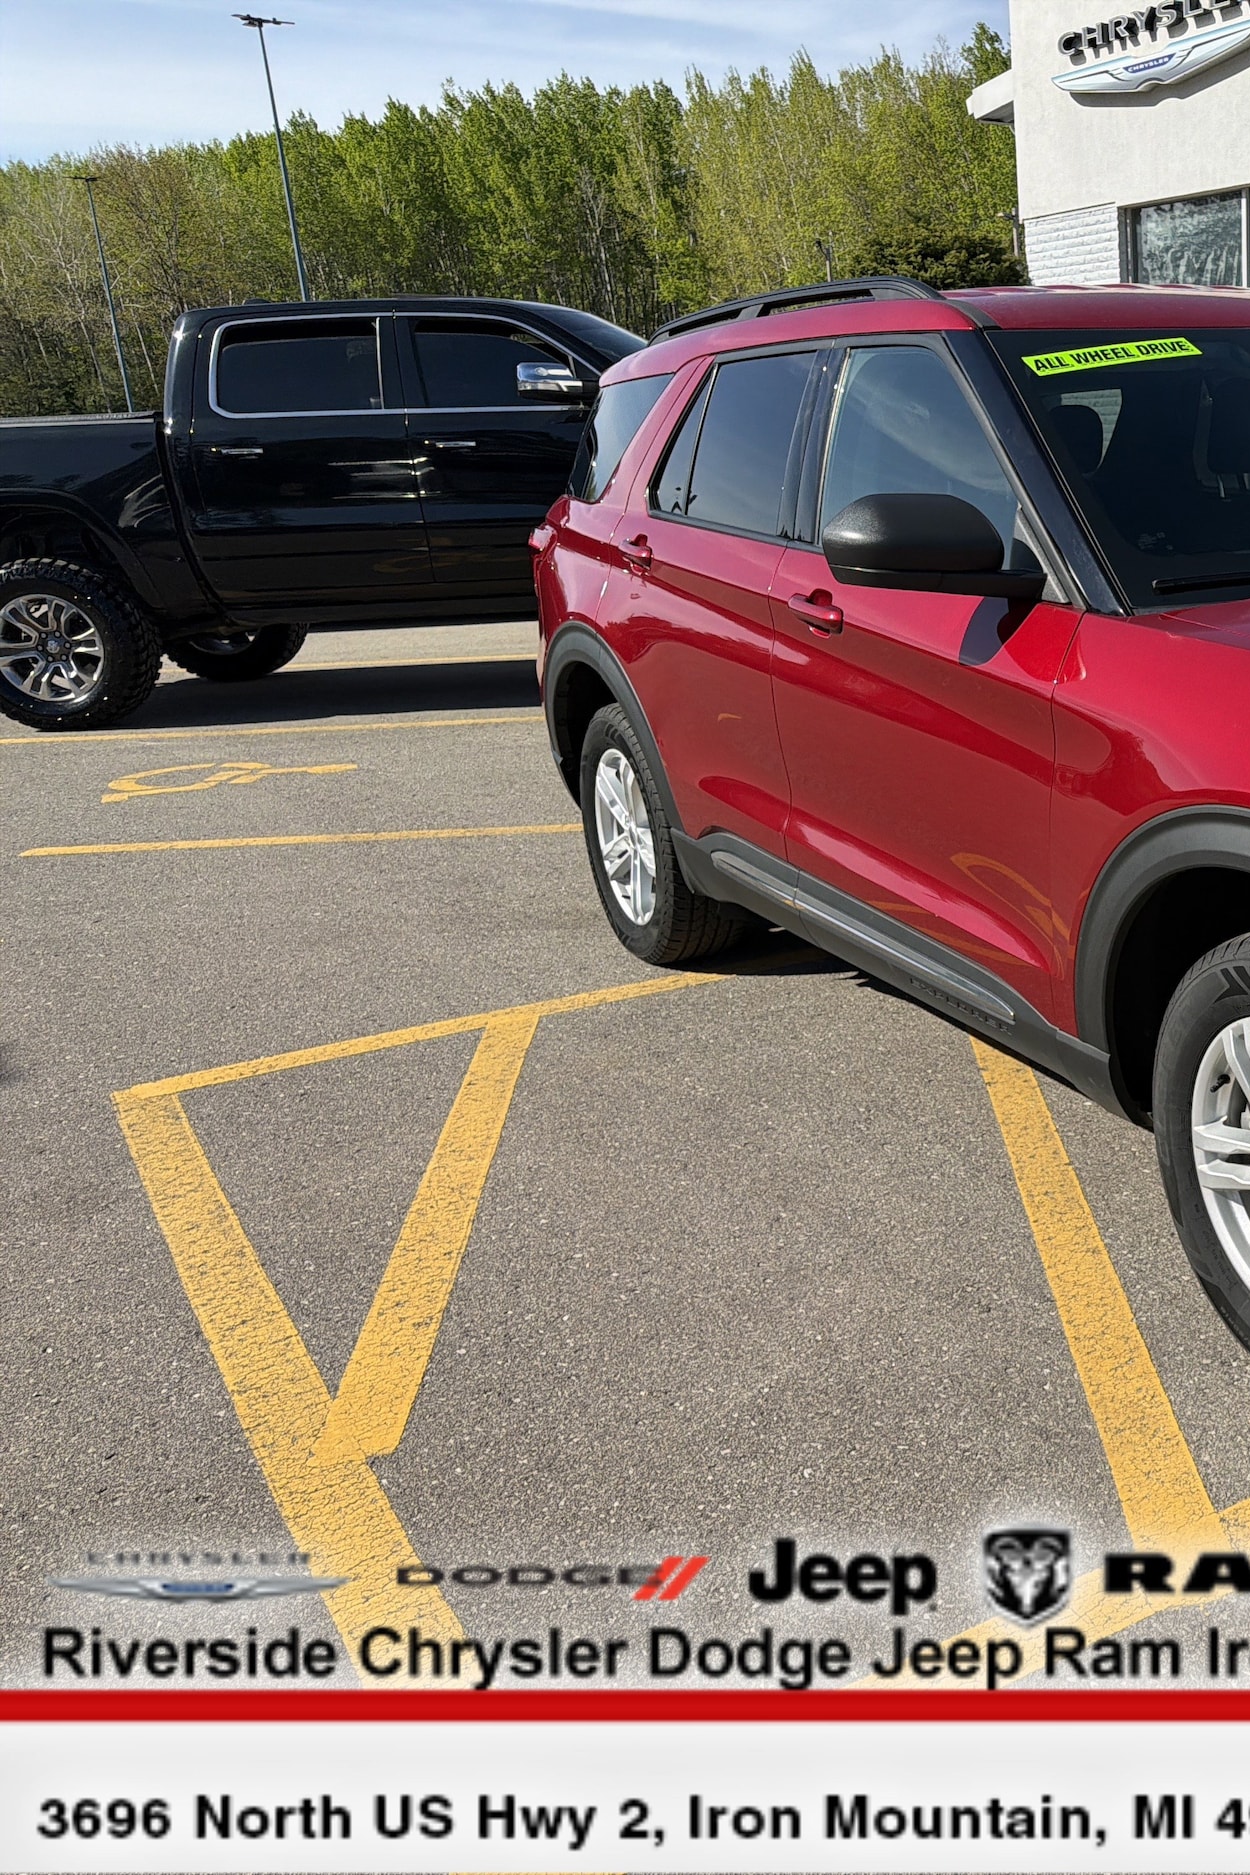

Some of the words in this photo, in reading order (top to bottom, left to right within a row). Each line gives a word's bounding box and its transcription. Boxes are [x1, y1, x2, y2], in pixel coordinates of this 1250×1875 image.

[1058, 0, 1233, 55] CHRYSL
[1127, 57, 1169, 72] CHRYSLER
[1033, 355, 1070, 372] ALL
[1070, 346, 1135, 366] WHEEL
[1135, 340, 1191, 357] DRIVE
